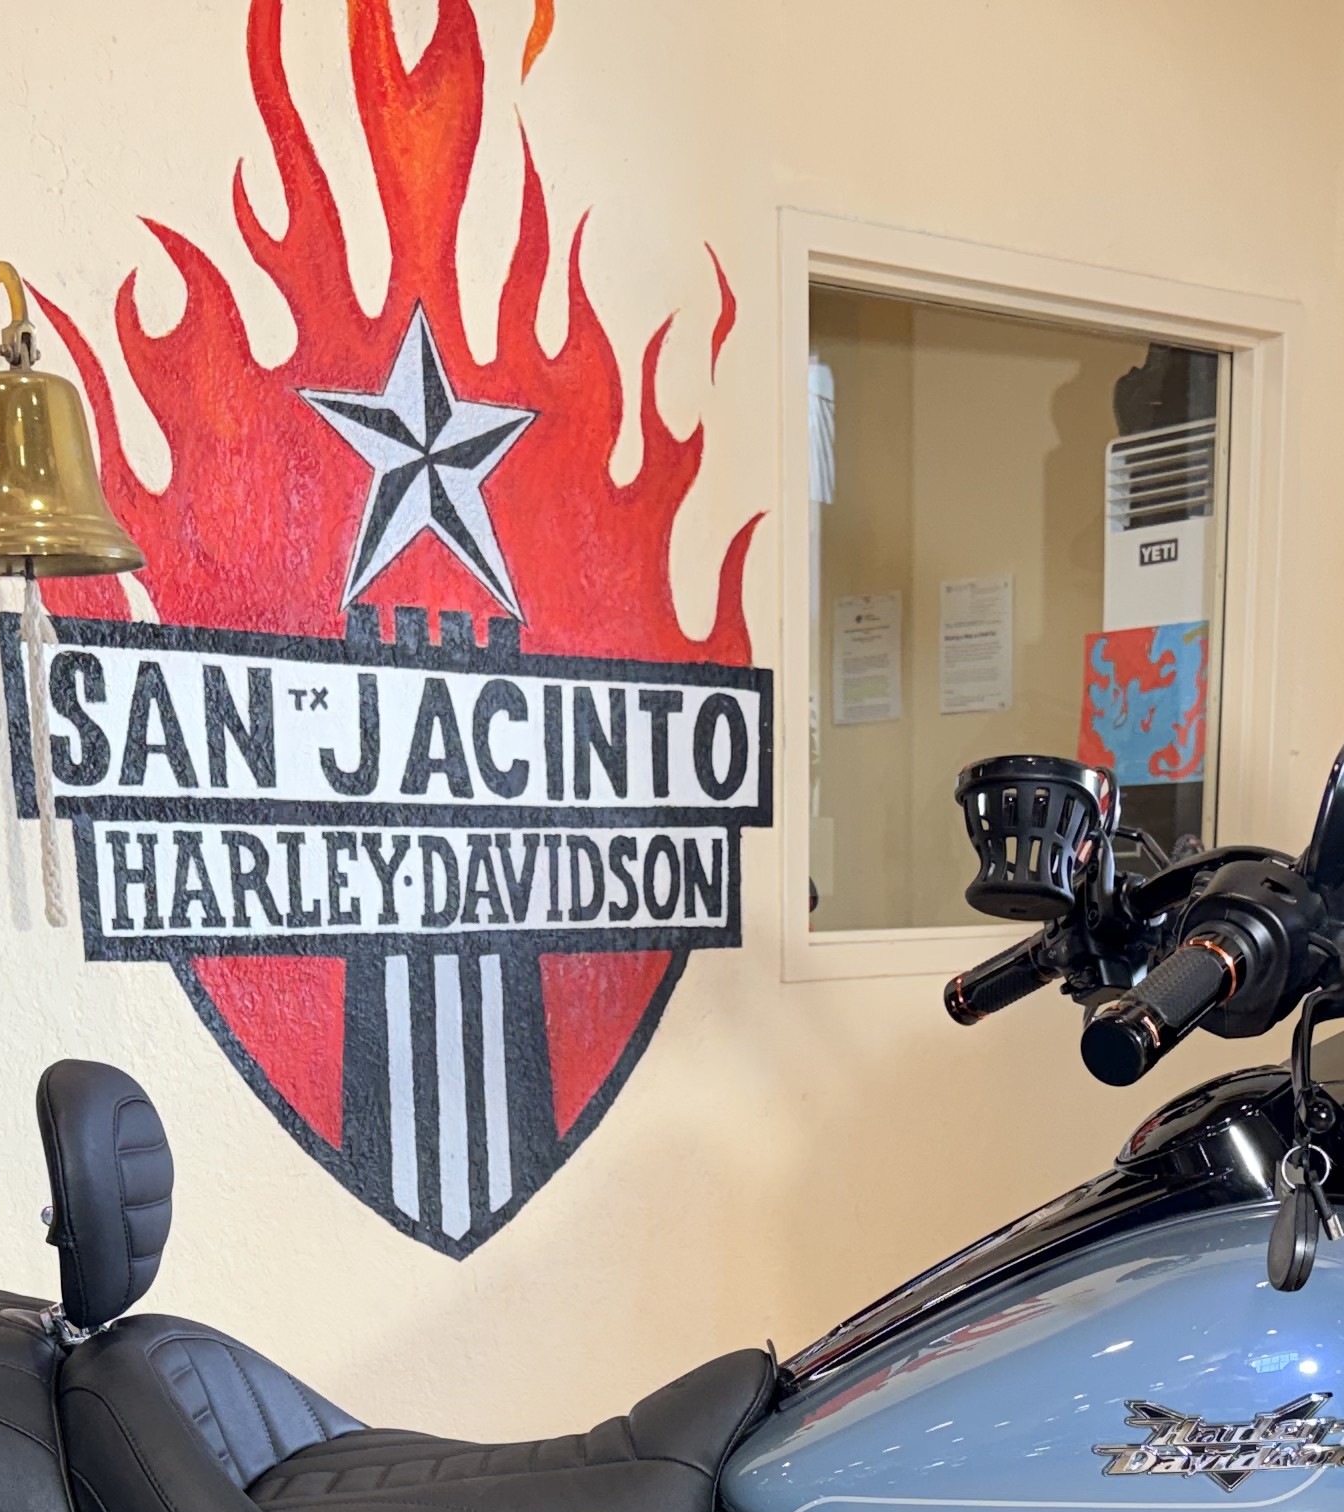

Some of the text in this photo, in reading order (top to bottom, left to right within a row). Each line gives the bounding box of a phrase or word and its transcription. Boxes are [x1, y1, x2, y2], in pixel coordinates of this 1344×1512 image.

[1142, 542, 1176, 563] YETI
[49, 651, 750, 801] SAN TX JACINTO
